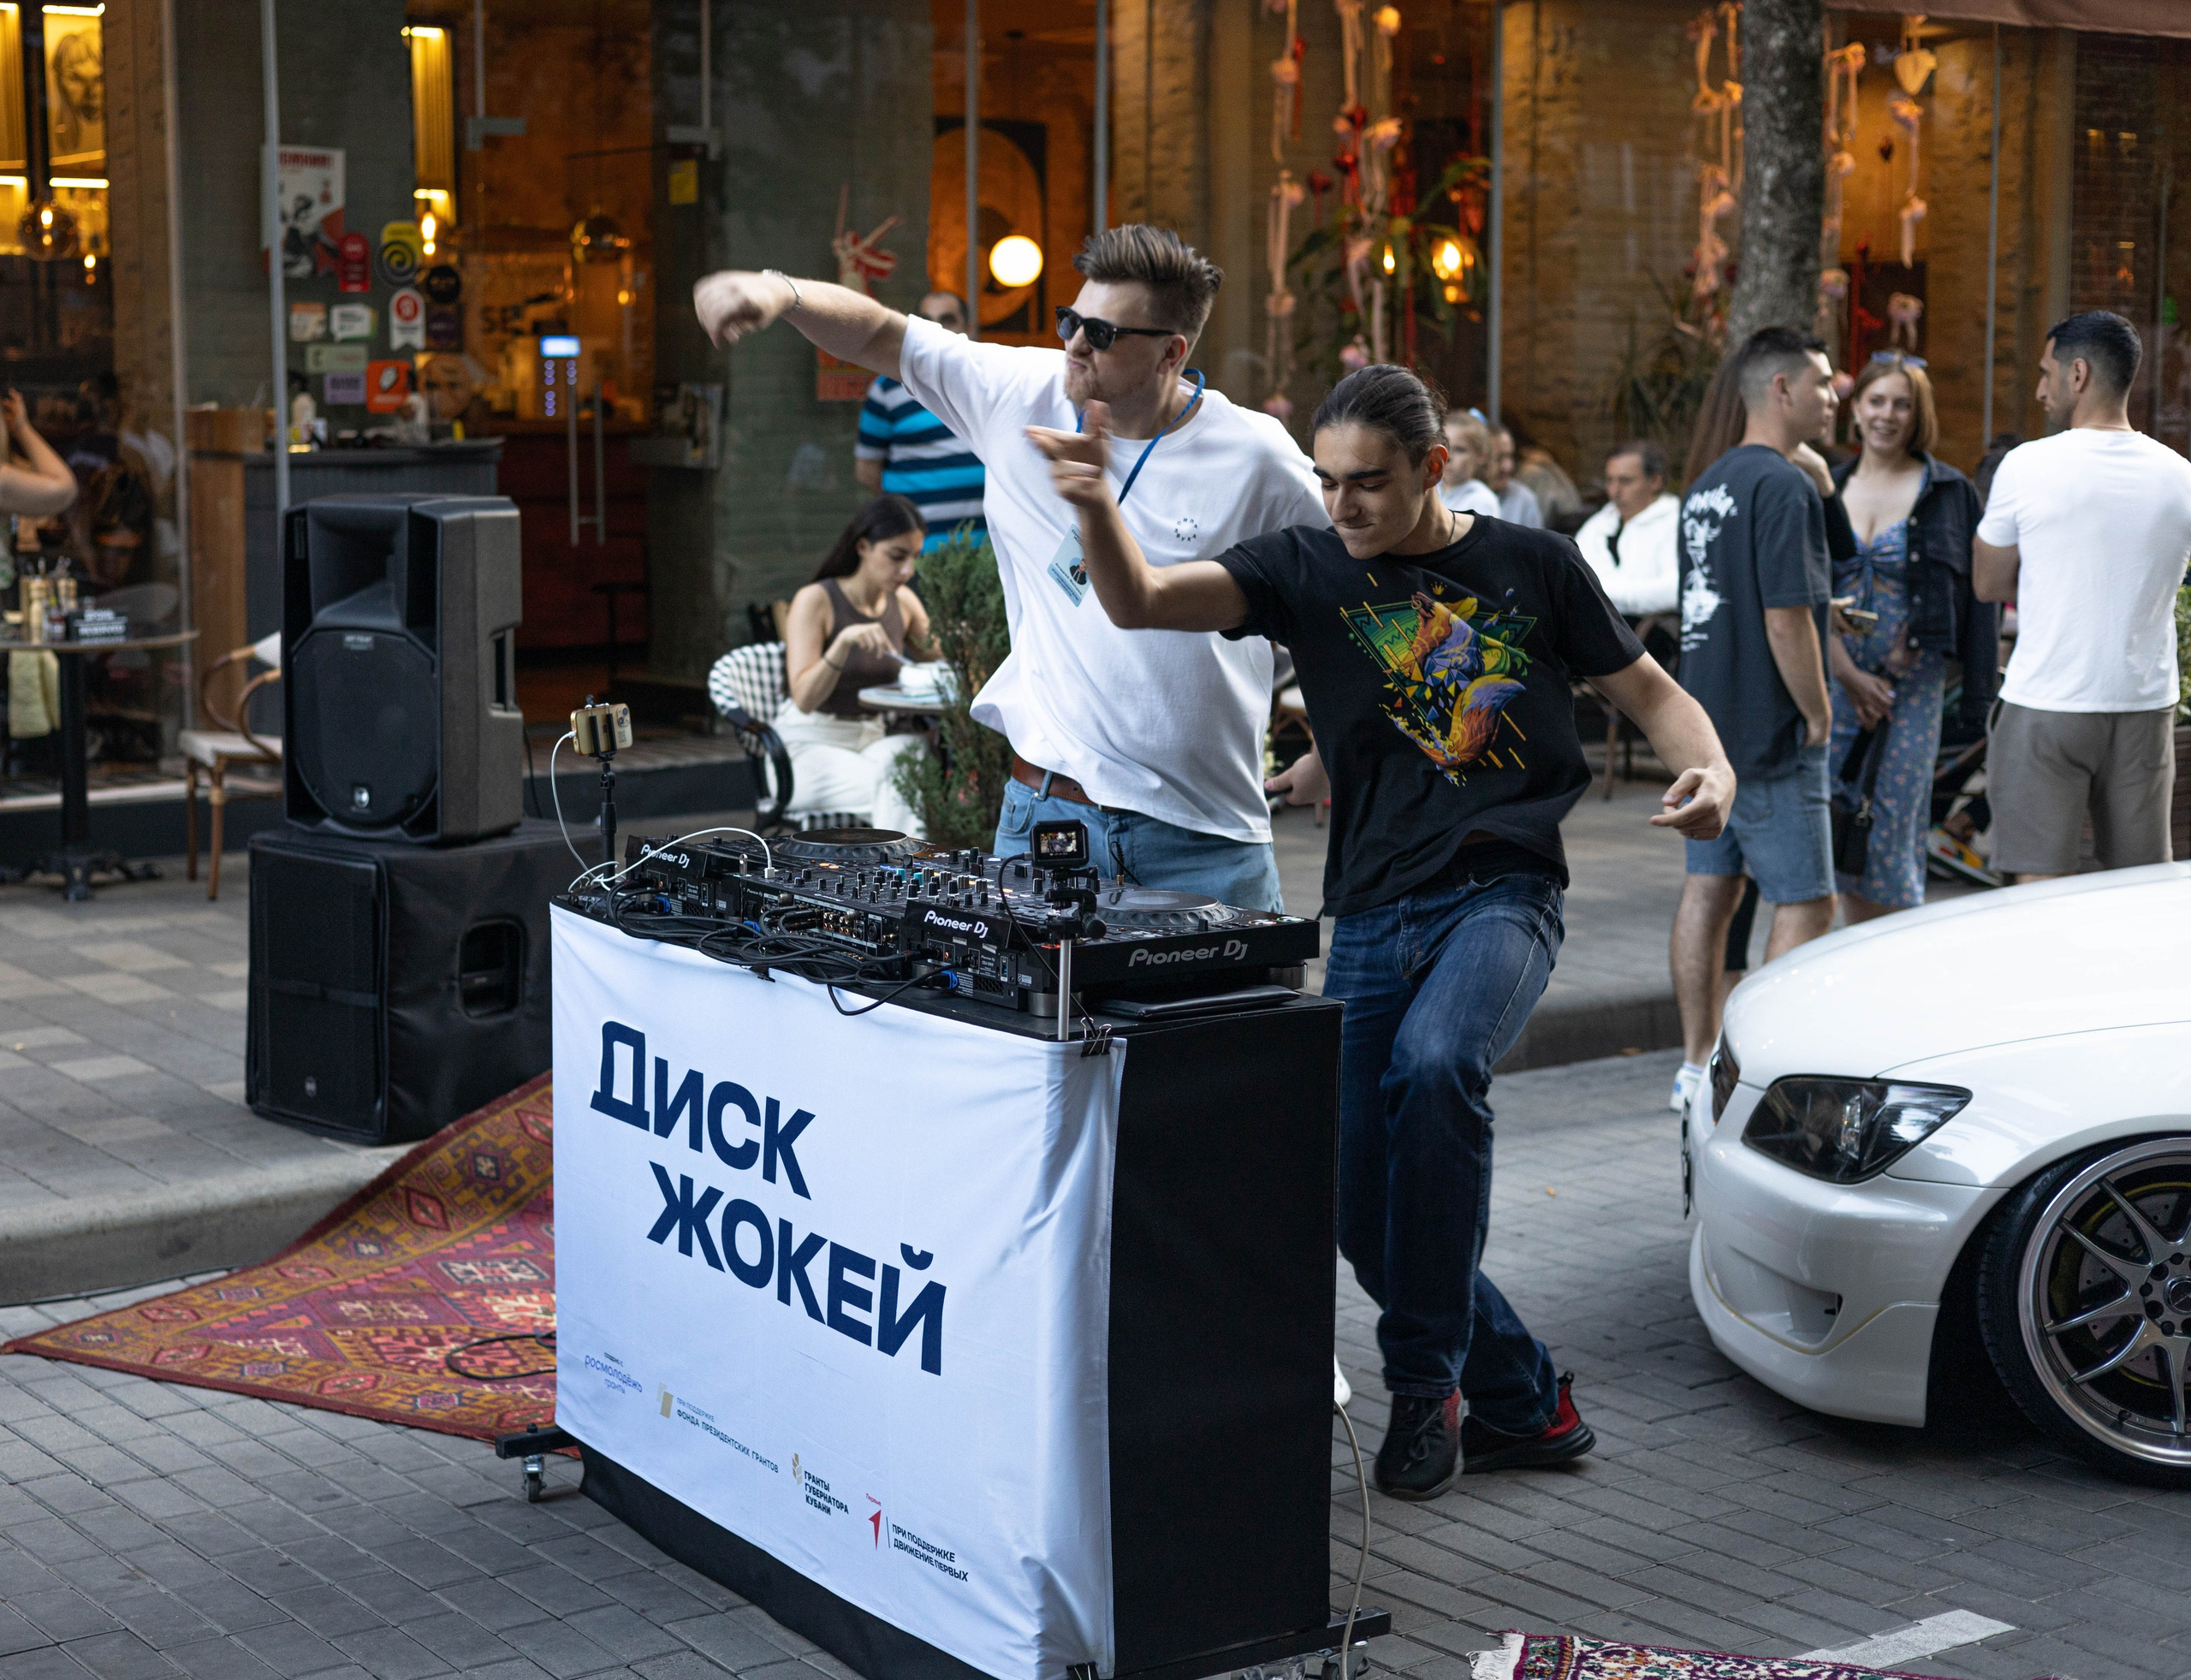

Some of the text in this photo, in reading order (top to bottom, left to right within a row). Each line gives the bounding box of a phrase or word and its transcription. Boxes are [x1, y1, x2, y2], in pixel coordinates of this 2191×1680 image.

[924, 910, 972, 931] Pioneer
[1128, 947, 1219, 967] Pioneer
[590, 1021, 816, 1200] ДИСК
[647, 1161, 947, 1375] ЖОКЕЙ
[677, 1410, 779, 1473] ФОНДА ПРЕЗИДЕНТСКИХ ГРАНТОВ
[805, 1469, 830, 1492] ГРАНТЫ
[805, 1482, 849, 1514] ГУБЕРНАТОРА
[805, 1493, 831, 1516] КУБАНИ
[892, 1523, 955, 1563] ПРИ ПОДДЕРЖКЕ
[894, 1538, 969, 1582] ДВИЖЕНИЕ ПЕРВЫХ
